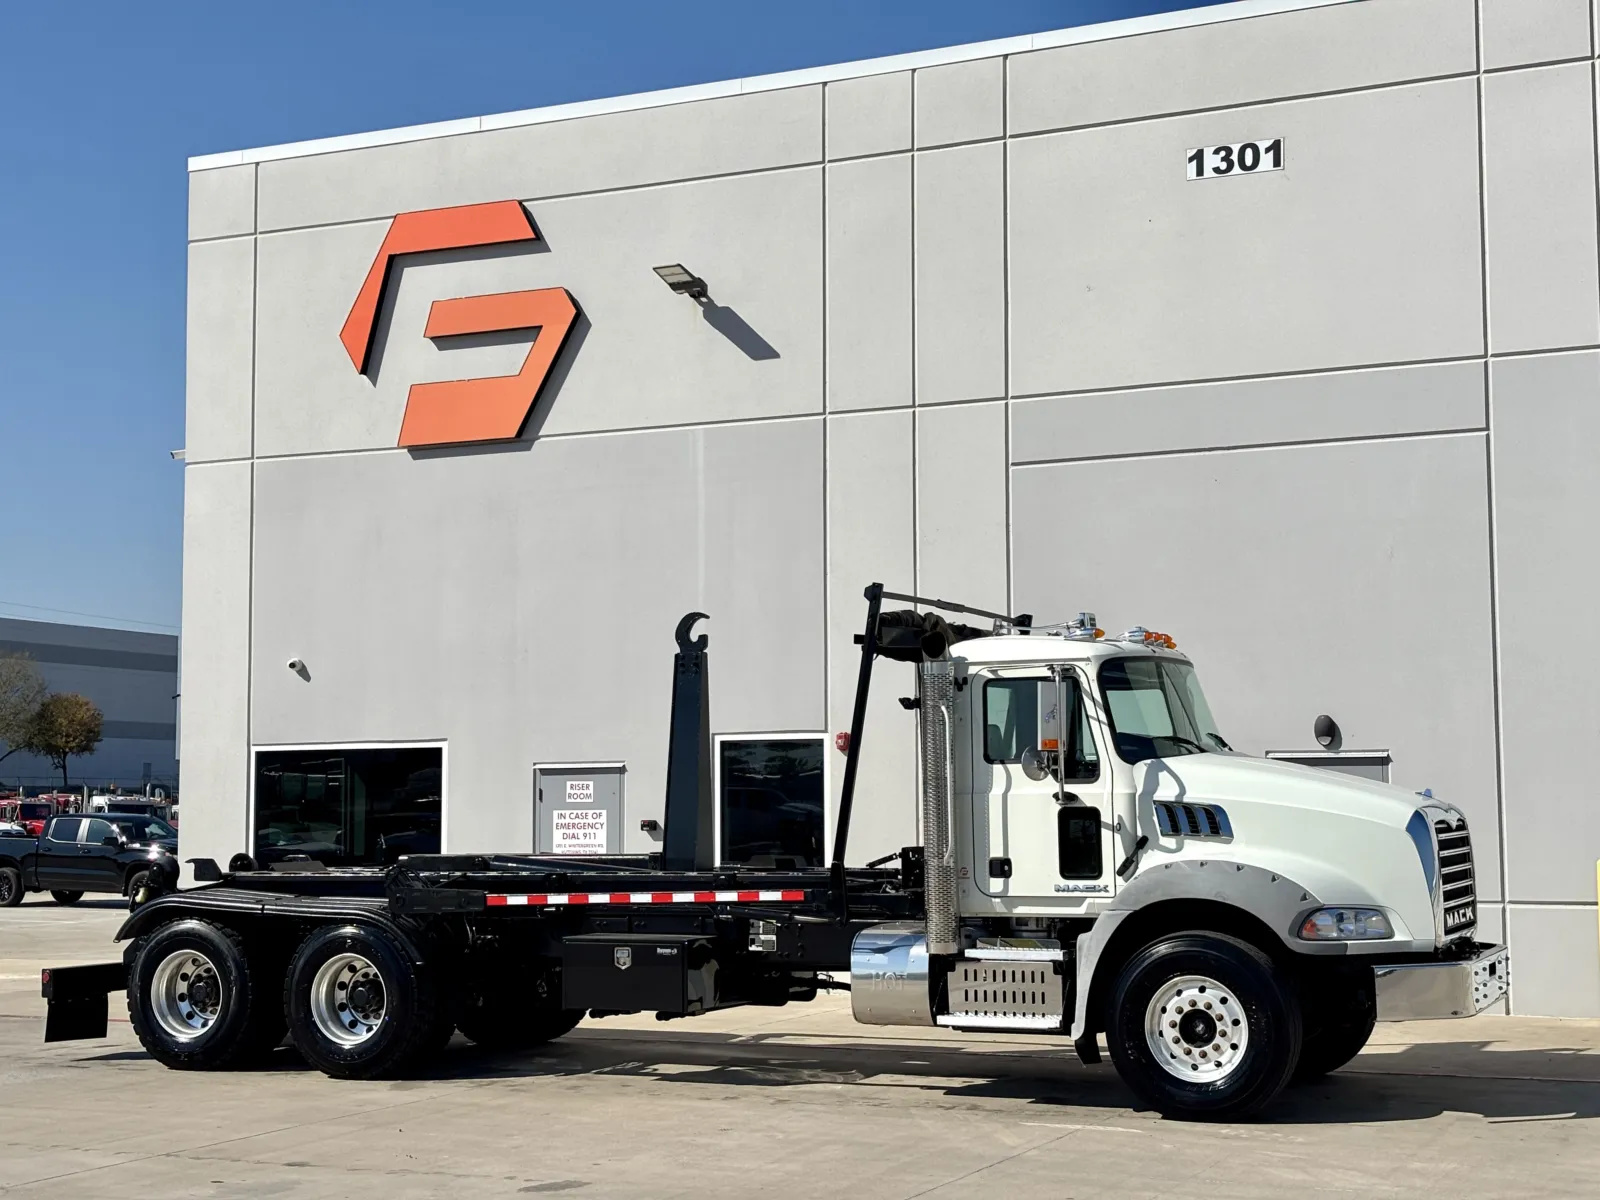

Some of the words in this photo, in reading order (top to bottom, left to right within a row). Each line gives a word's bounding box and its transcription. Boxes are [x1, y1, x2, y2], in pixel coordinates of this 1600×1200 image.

[1187, 138, 1282, 178] 1301
[570, 783, 590, 791] RISER
[567, 792, 592, 800] ROOM
[557, 812, 567, 820] IN
[568, 812, 589, 820] CASE
[591, 812, 603, 820] OF
[555, 822, 605, 830] EMERGENCY
[562, 832, 581, 840] DIAL
[582, 832, 597, 840] 911
[1054, 884, 1109, 893] MACK
[1446, 907, 1474, 927] MACK
